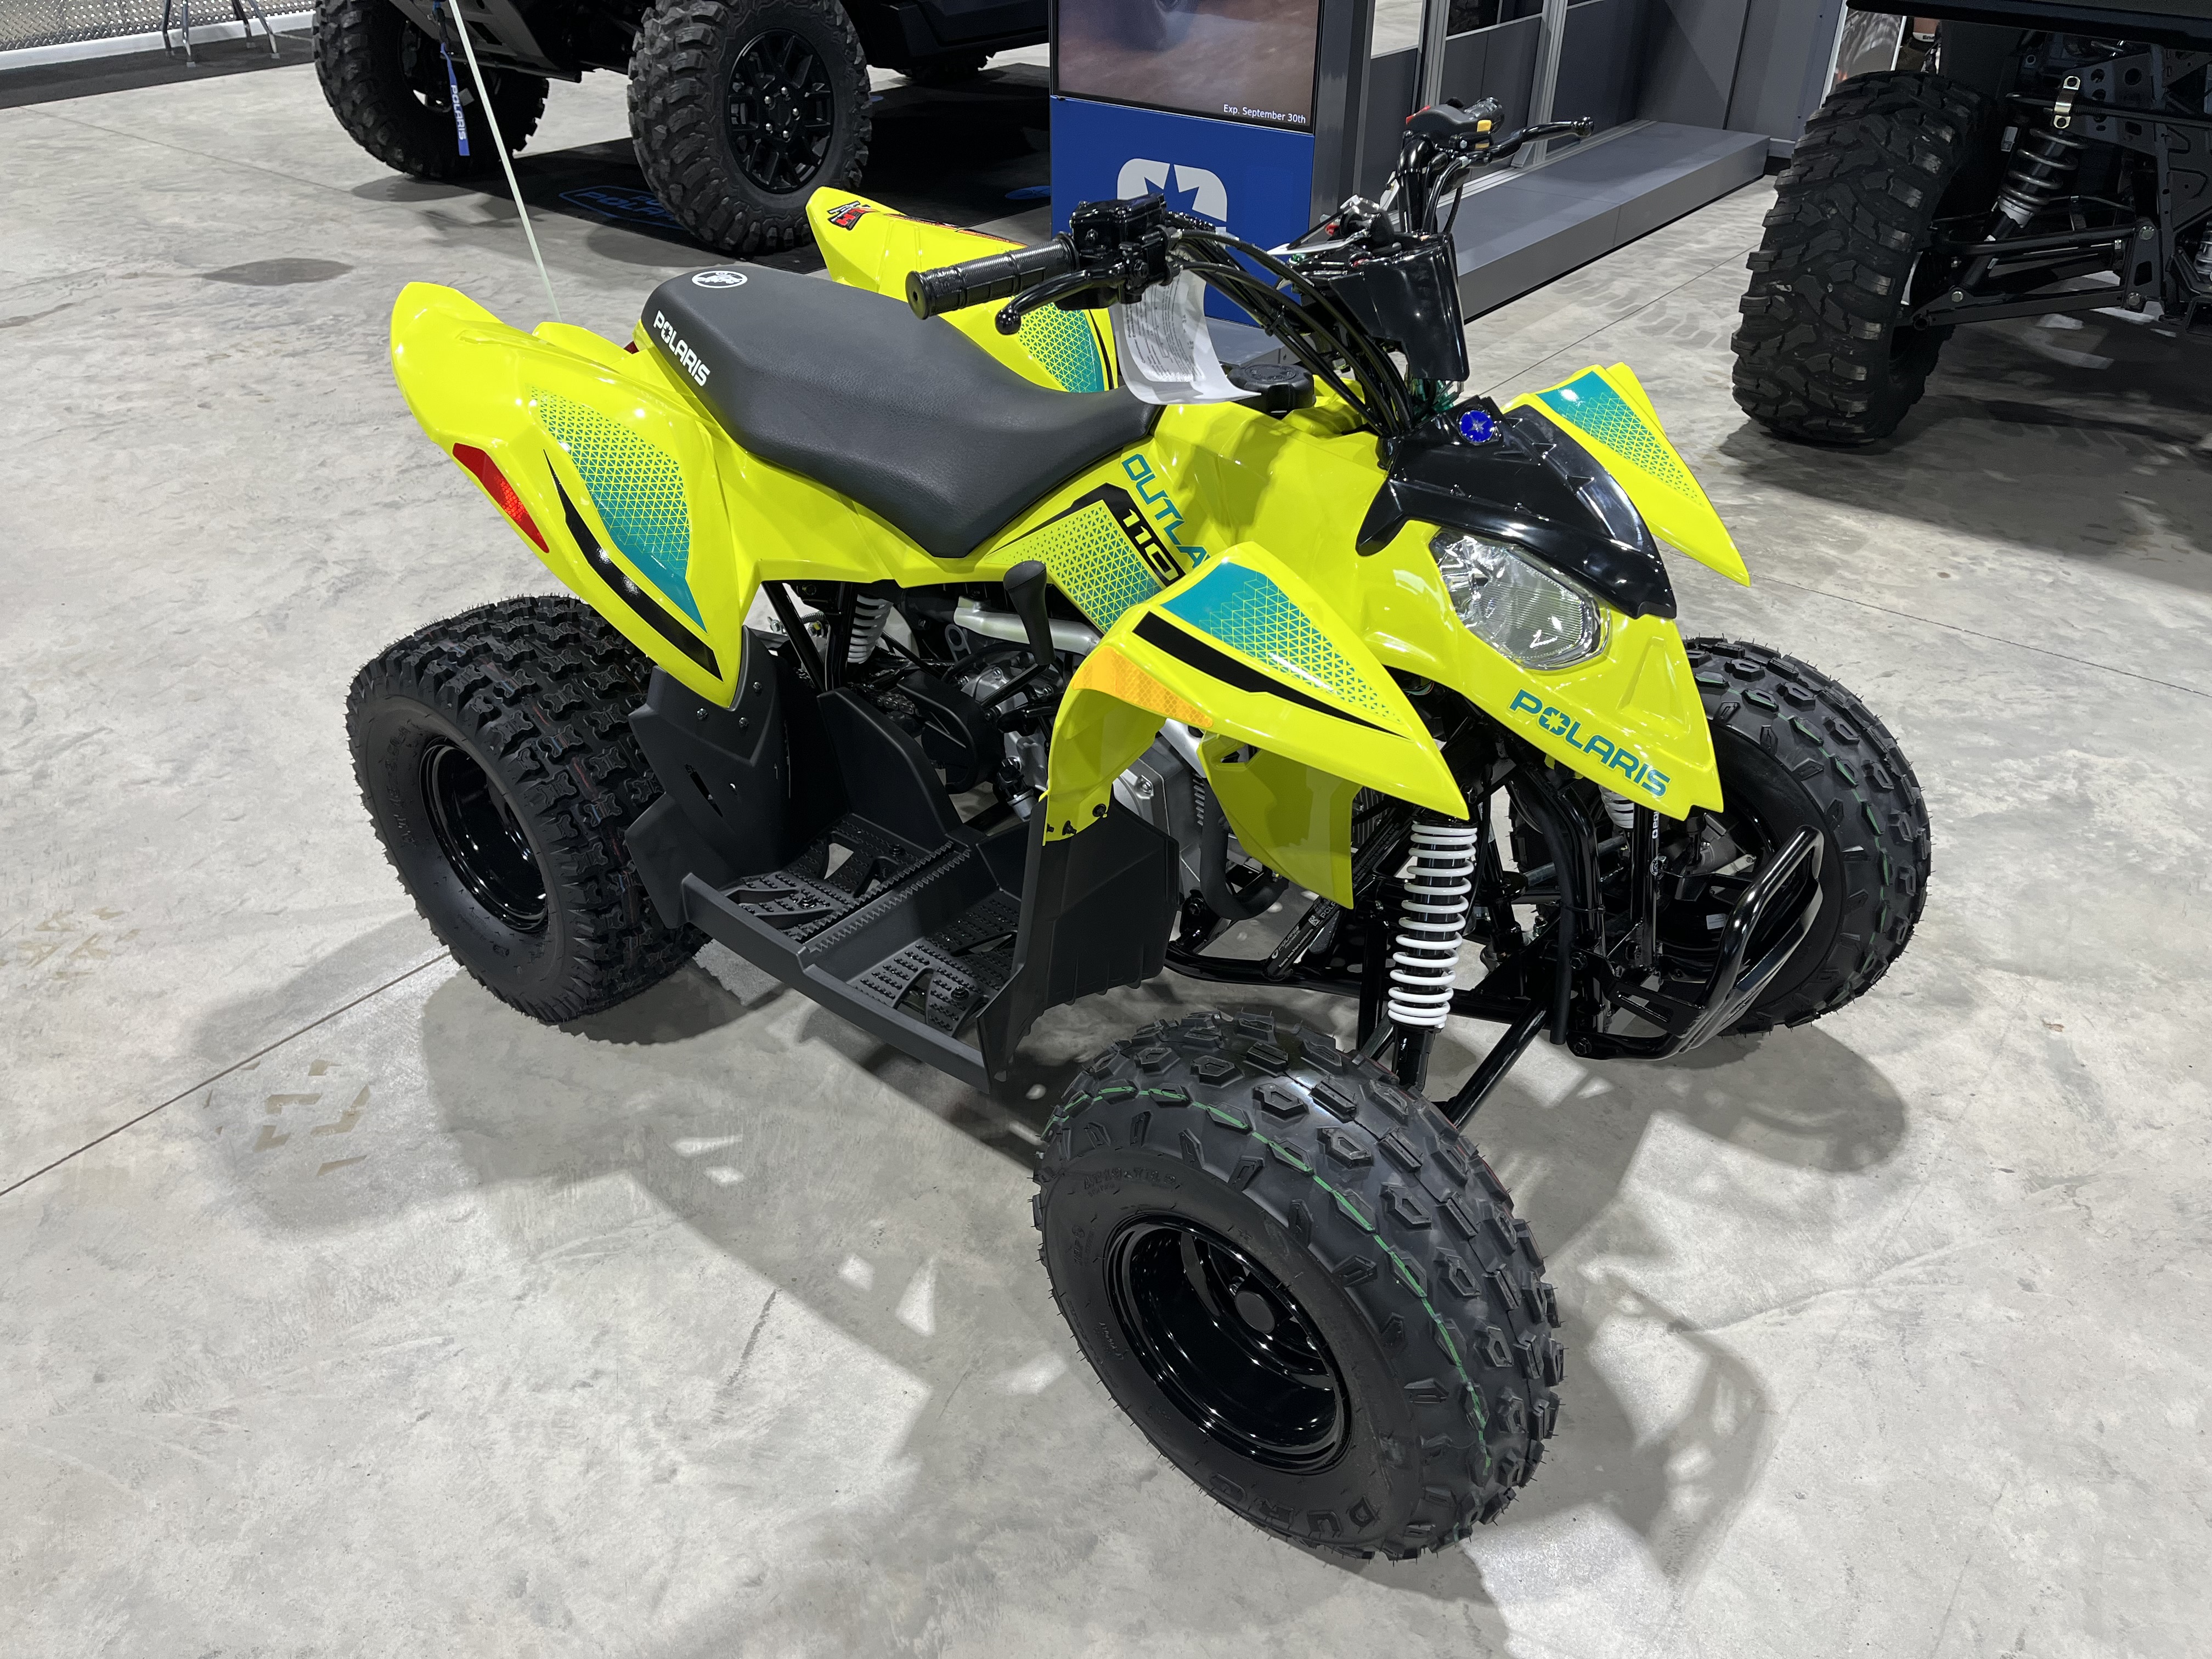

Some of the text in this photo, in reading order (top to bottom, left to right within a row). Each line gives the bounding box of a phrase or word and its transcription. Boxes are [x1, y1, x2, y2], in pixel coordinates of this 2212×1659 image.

[450, 84, 467, 140] POLARIS
[1223, 104, 1306, 124] Exp. September 30th
[574, 191, 677, 222] POLA
[653, 310, 710, 387] POLARIS
[1121, 453, 1211, 568] OUTLA
[1121, 509, 1180, 582] 110
[1509, 689, 1671, 798] POLARIS
